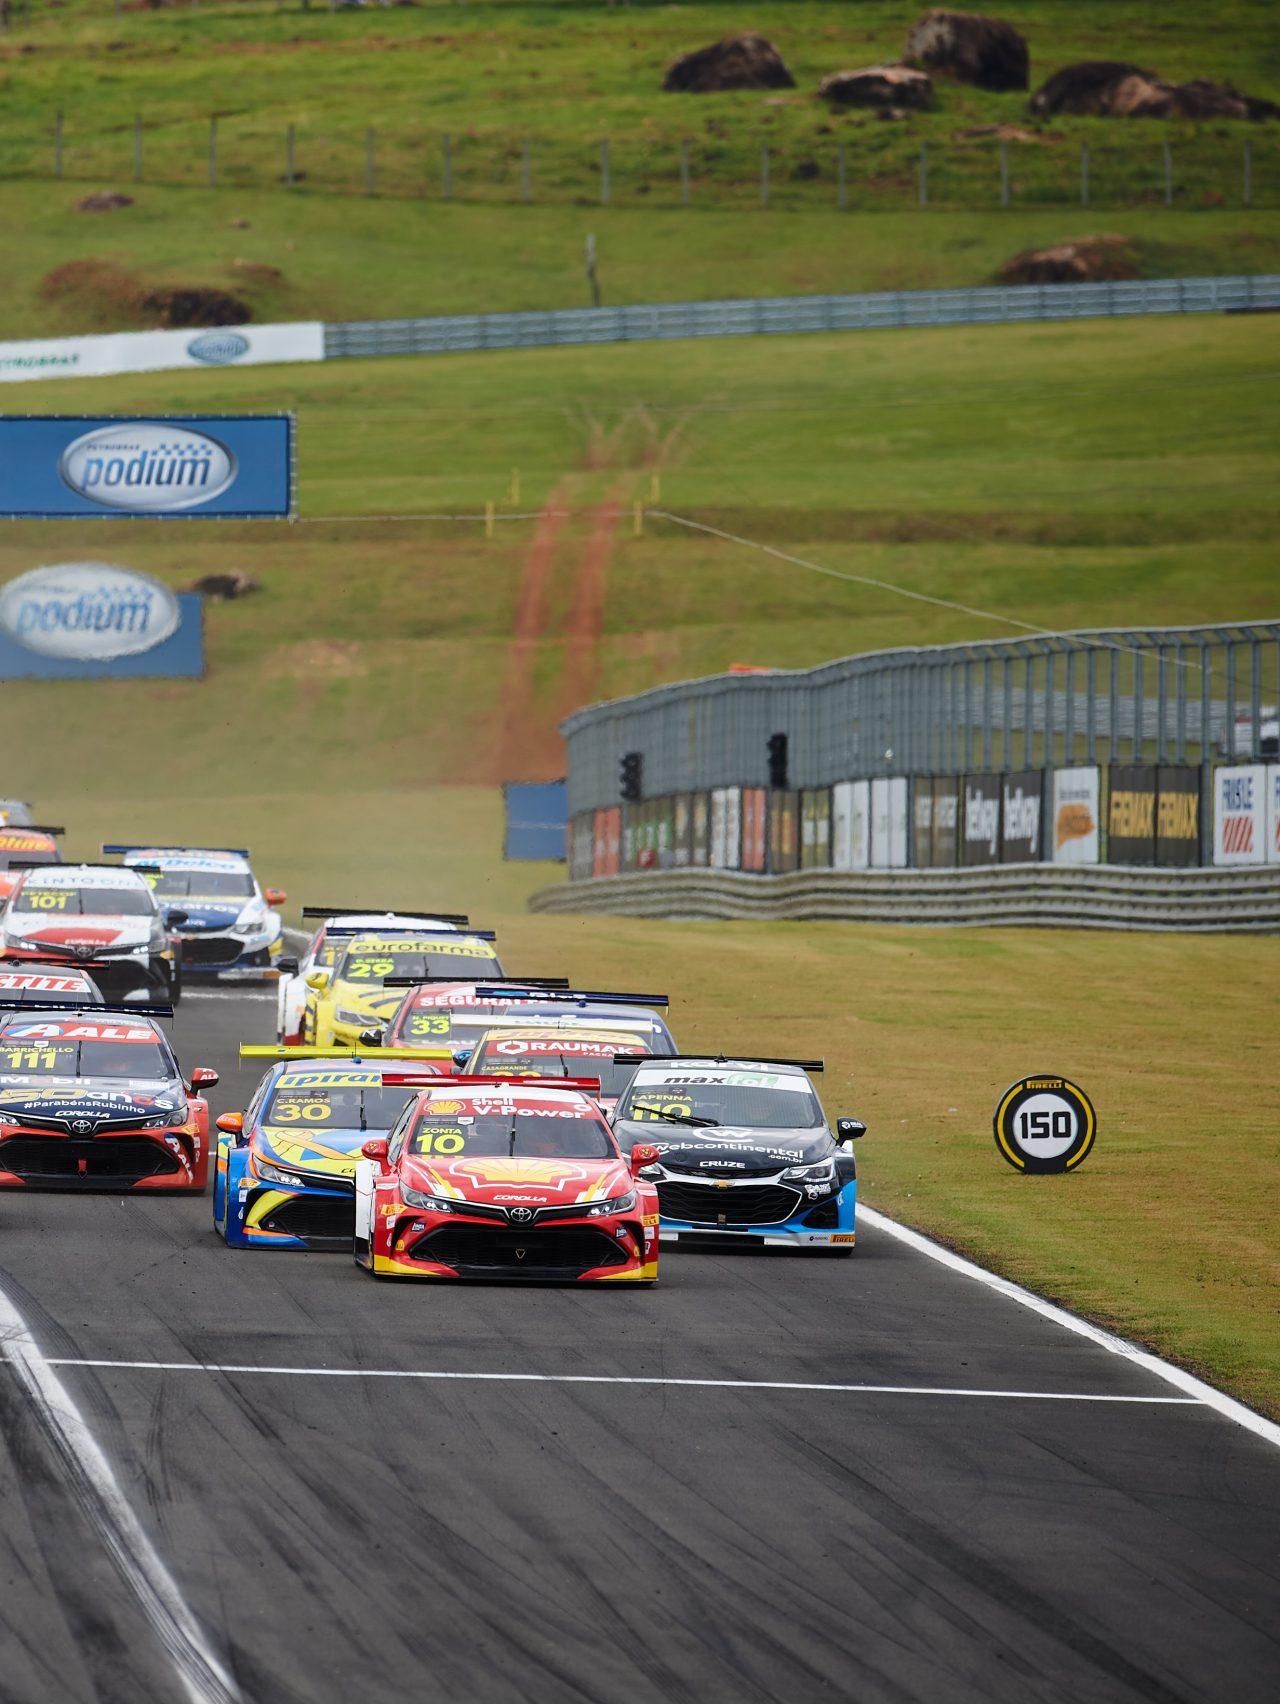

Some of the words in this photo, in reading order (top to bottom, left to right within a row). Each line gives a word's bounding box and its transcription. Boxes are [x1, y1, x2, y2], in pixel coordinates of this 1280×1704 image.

[86, 443, 141, 451] PETROBRAS
[82, 450, 211, 491] podium
[17, 594, 153, 633] podium
[29, 895, 68, 910] 101
[355, 940, 490, 957] eurofarma
[348, 963, 394, 978] 29
[64, 1026, 154, 1040] ALE
[410, 1019, 450, 1035] 33
[530, 1041, 637, 1055] RAUMAK
[7, 1052, 57, 1069] 111
[1026, 1080, 1063, 1089] PIRELLI
[472, 1097, 514, 1106] Shell
[55, 1110, 110, 1119] COROLLA
[274, 1104, 332, 1122] 30
[472, 1105, 586, 1119] V-Power
[1019, 1111, 1072, 1139] 150
[417, 1134, 465, 1154] 10
[699, 1160, 746, 1168] CRUZE
[493, 1194, 547, 1202] COROLLA
